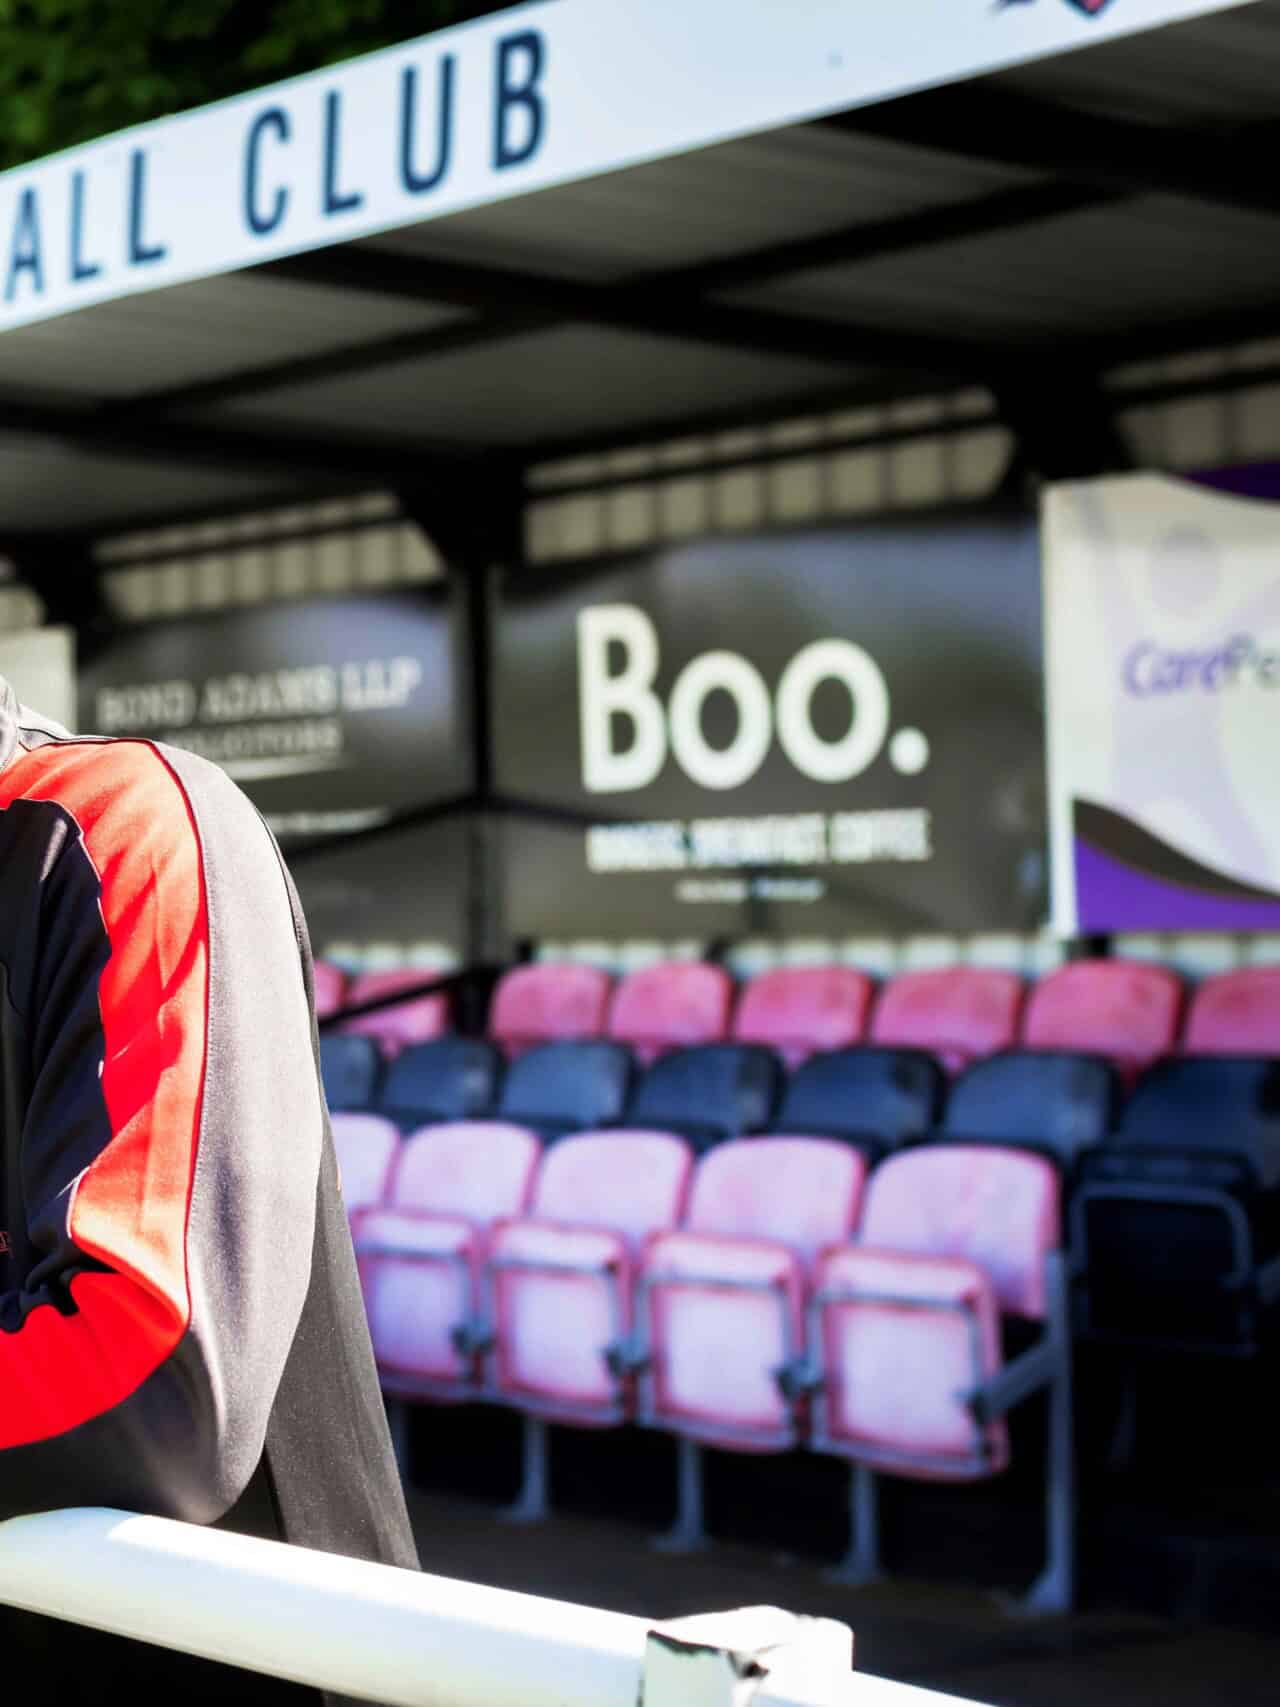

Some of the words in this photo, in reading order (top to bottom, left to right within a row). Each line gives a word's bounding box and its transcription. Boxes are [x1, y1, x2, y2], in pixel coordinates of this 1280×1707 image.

[243, 27, 549, 238] CLUB
[340, 656, 421, 711] LLP
[576, 602, 931, 793] Boo.
